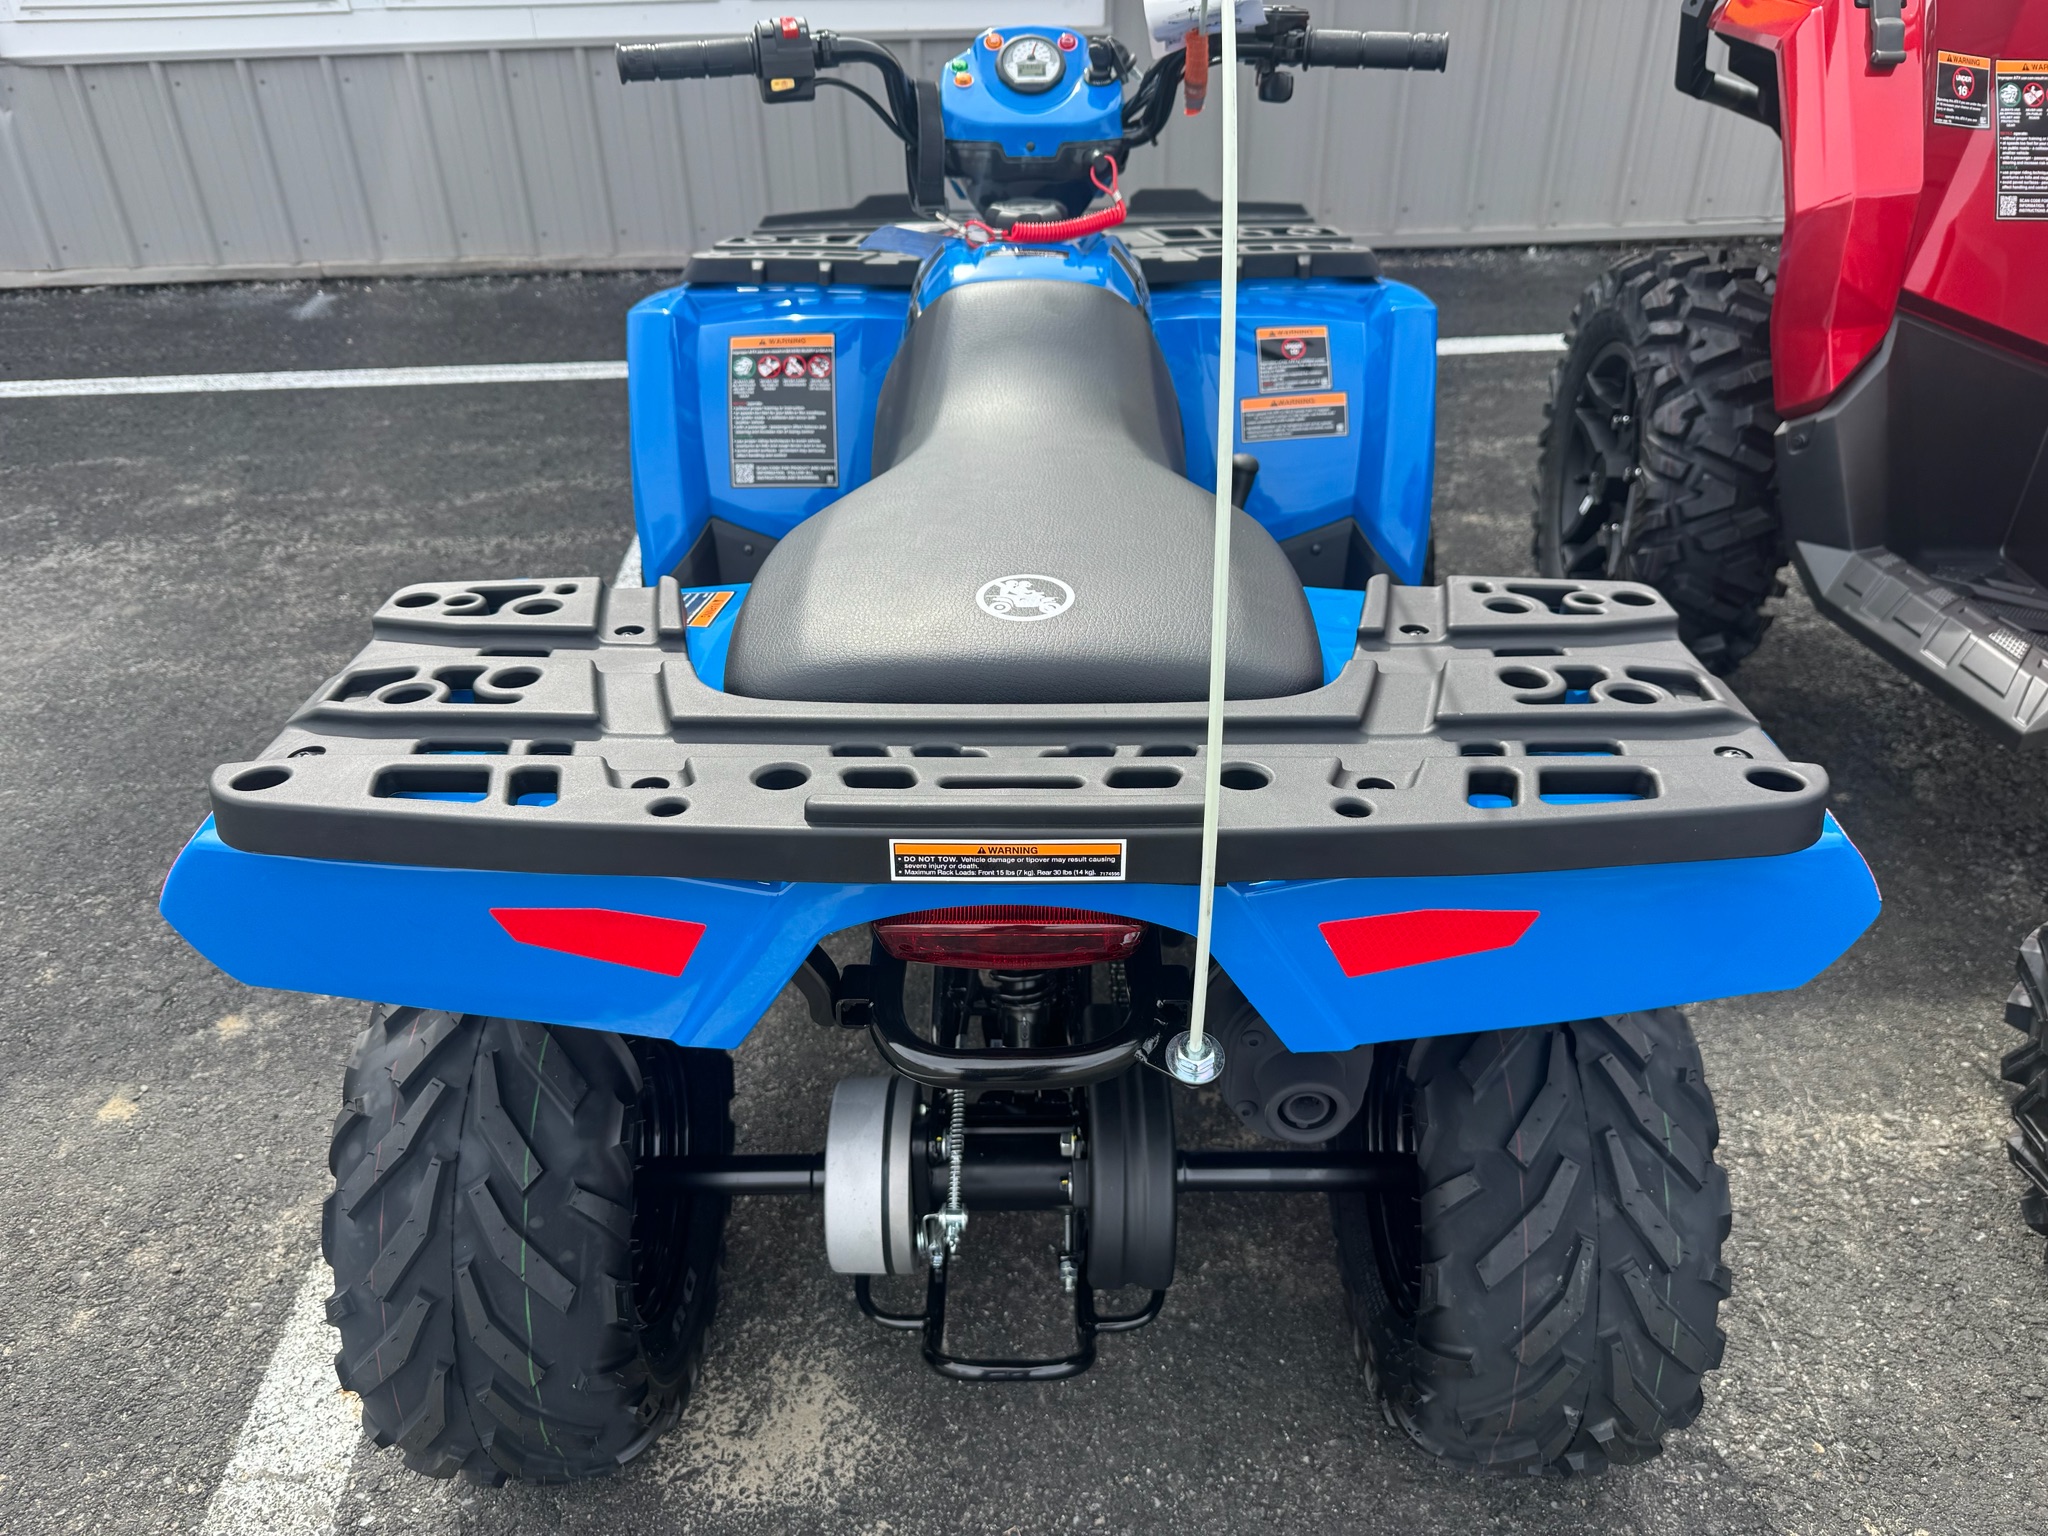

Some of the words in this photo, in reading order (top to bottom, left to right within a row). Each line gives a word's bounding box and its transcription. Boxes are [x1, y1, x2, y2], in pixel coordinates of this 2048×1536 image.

[1952, 55, 1981, 67] WARNING
[1955, 74, 1972, 83] UNDER
[1957, 85, 1968, 97] 16
[987, 846, 1039, 855] WARNING
[987, 856, 1016, 864] damage
[1088, 856, 1116, 864] causing
[1016, 869, 1023, 877] (7
[1073, 869, 1084, 877] (14
